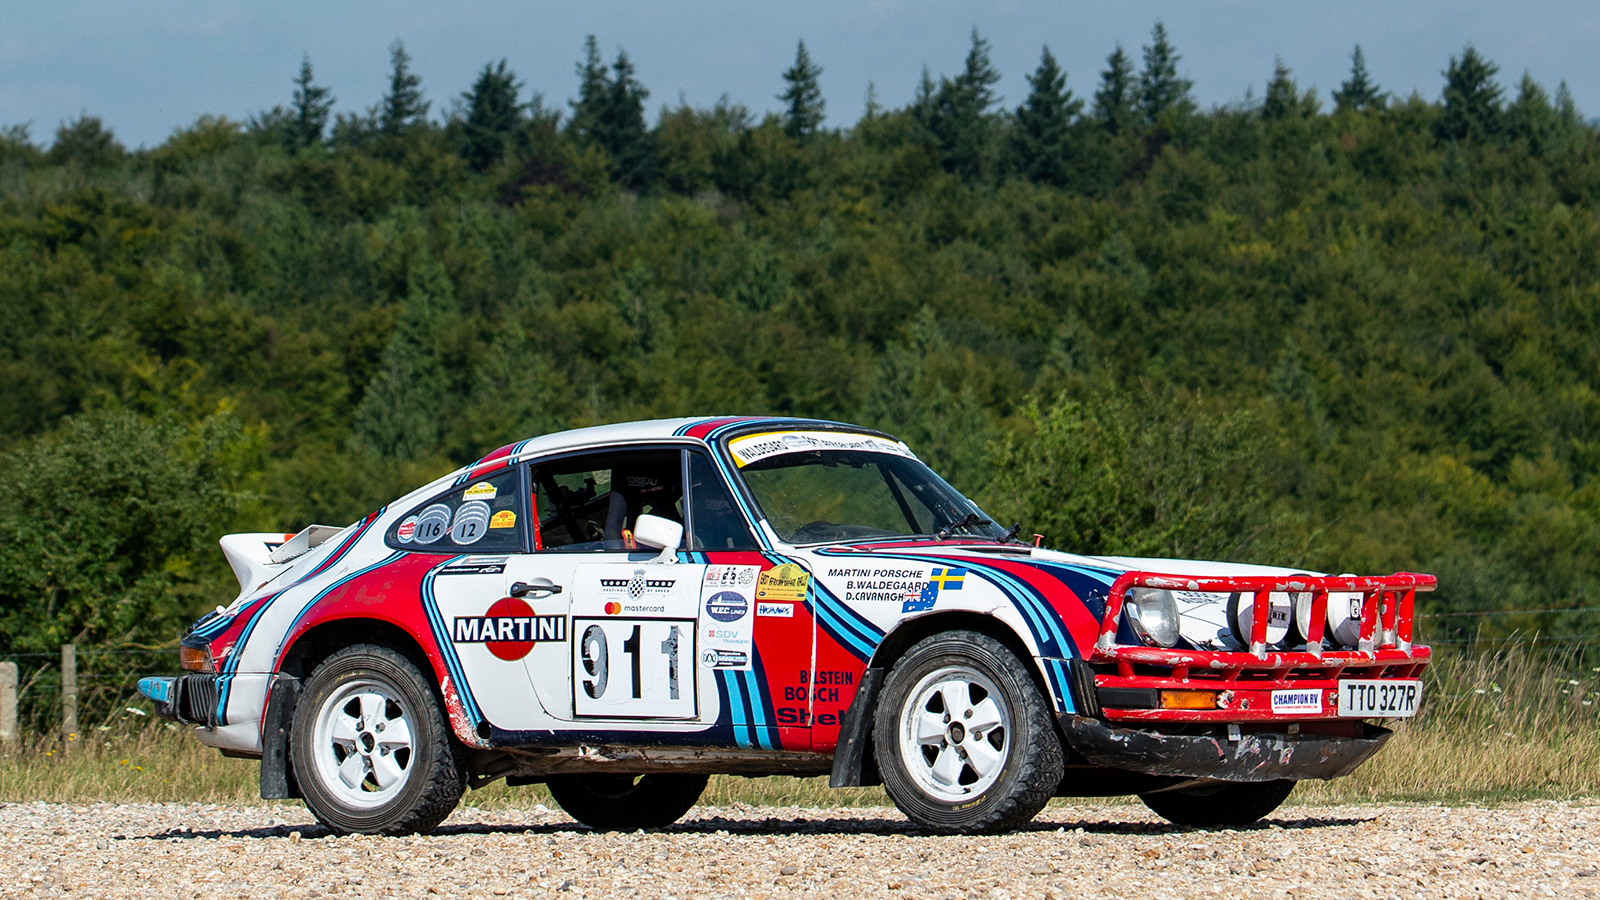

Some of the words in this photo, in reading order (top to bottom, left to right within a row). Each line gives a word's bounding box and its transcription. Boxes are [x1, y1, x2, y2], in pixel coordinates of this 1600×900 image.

[418, 522, 441, 538] 116
[461, 523, 477, 538] 12
[828, 569, 871, 577] MARTINI
[873, 569, 924, 578] PORSCHE
[846, 580, 930, 590] B.WALDEGAARD
[845, 592, 905, 602] D.CAVANAGH
[624, 605, 665, 613] mastercard
[456, 616, 564, 641] MARTINI
[716, 630, 739, 638] SDV
[581, 624, 680, 700] 911
[1273, 693, 1309, 705] CHAMPION
[1310, 693, 1318, 704] RV
[1347, 684, 1376, 711] TTO
[1379, 685, 1416, 711] 327R
[776, 707, 846, 726] Shel
